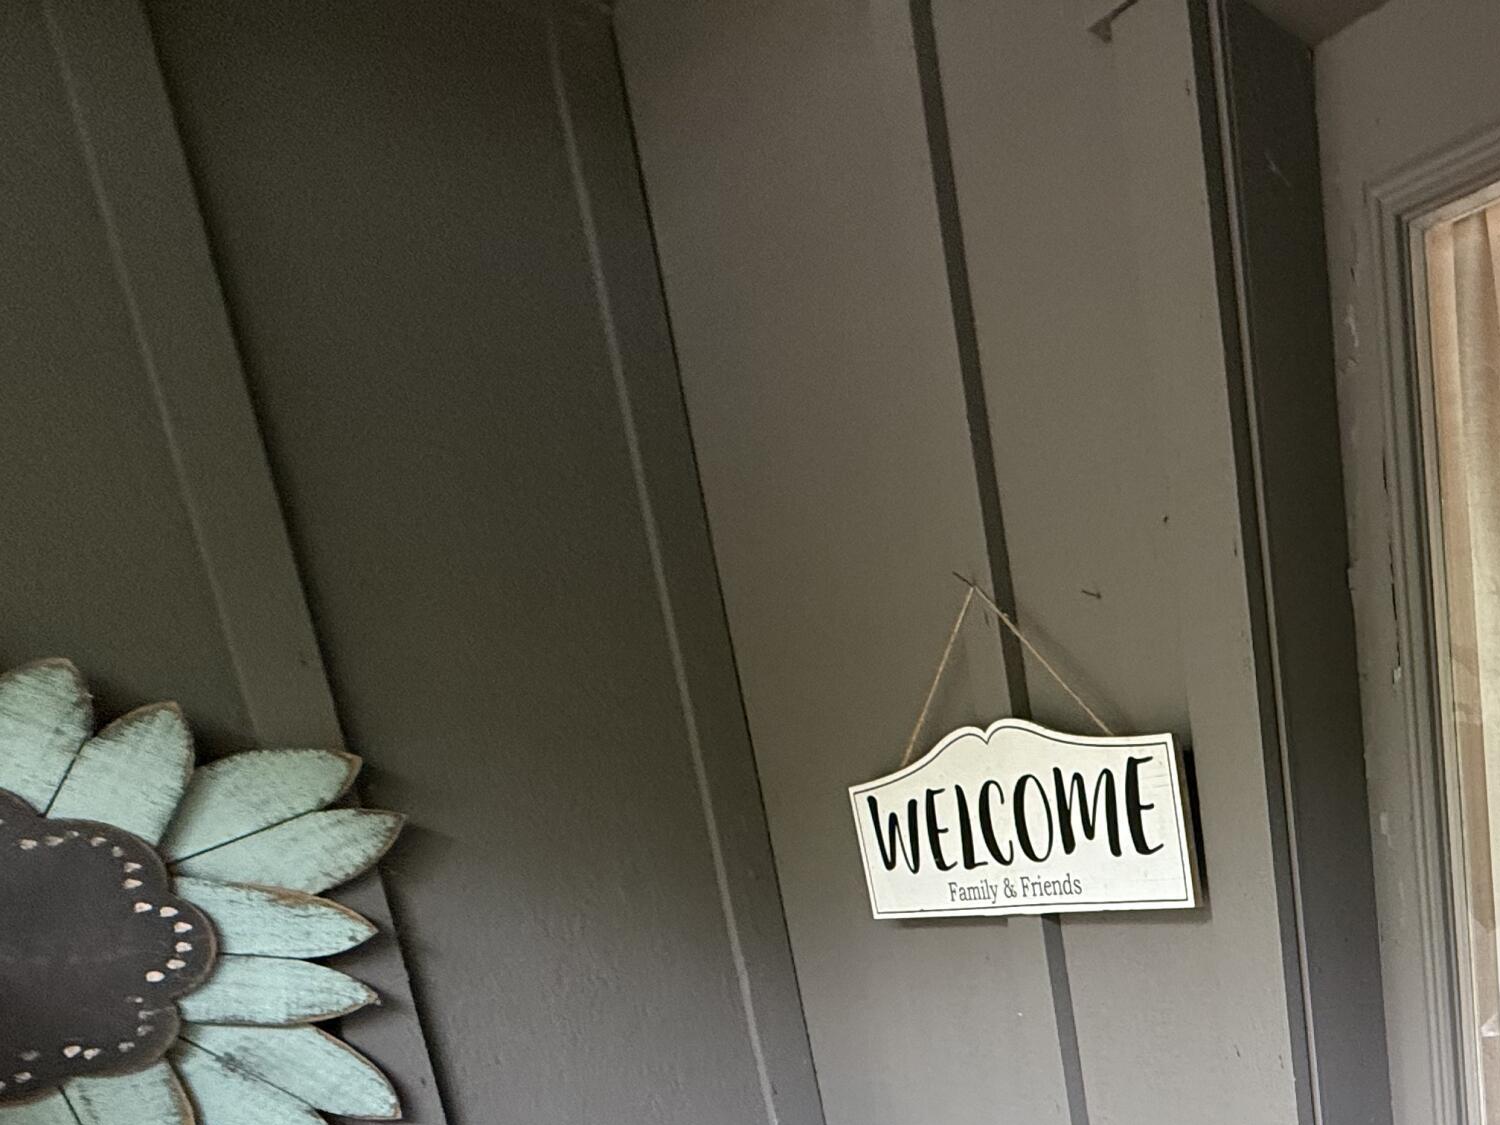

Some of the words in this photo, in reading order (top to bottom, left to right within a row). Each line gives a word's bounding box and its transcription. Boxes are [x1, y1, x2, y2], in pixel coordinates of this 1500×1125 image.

[867, 756, 1164, 874] WELCOME
[948, 880, 998, 904] Family
[1003, 877, 1017, 898] &
[1020, 872, 1082, 897] Friends
